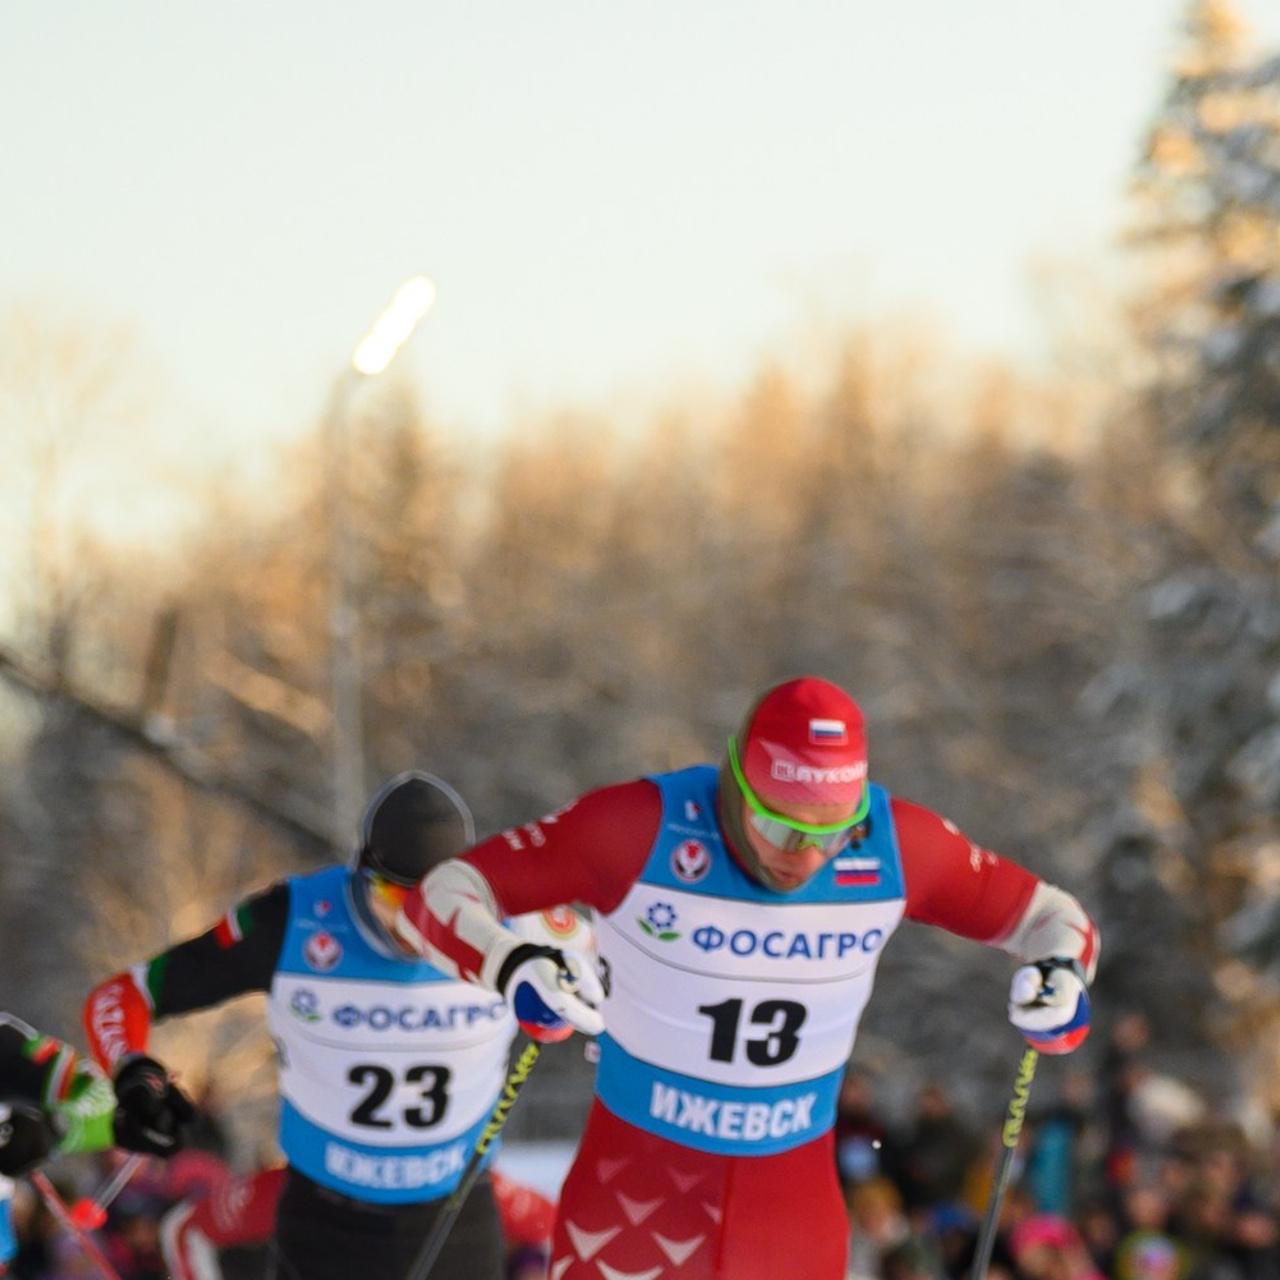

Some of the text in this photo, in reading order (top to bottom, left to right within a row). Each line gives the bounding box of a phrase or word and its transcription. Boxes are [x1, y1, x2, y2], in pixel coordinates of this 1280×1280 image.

[697, 998, 807, 1067] 13
[347, 1064, 451, 1128] 23
[650, 1082, 817, 1140] ИЖЕВСК
